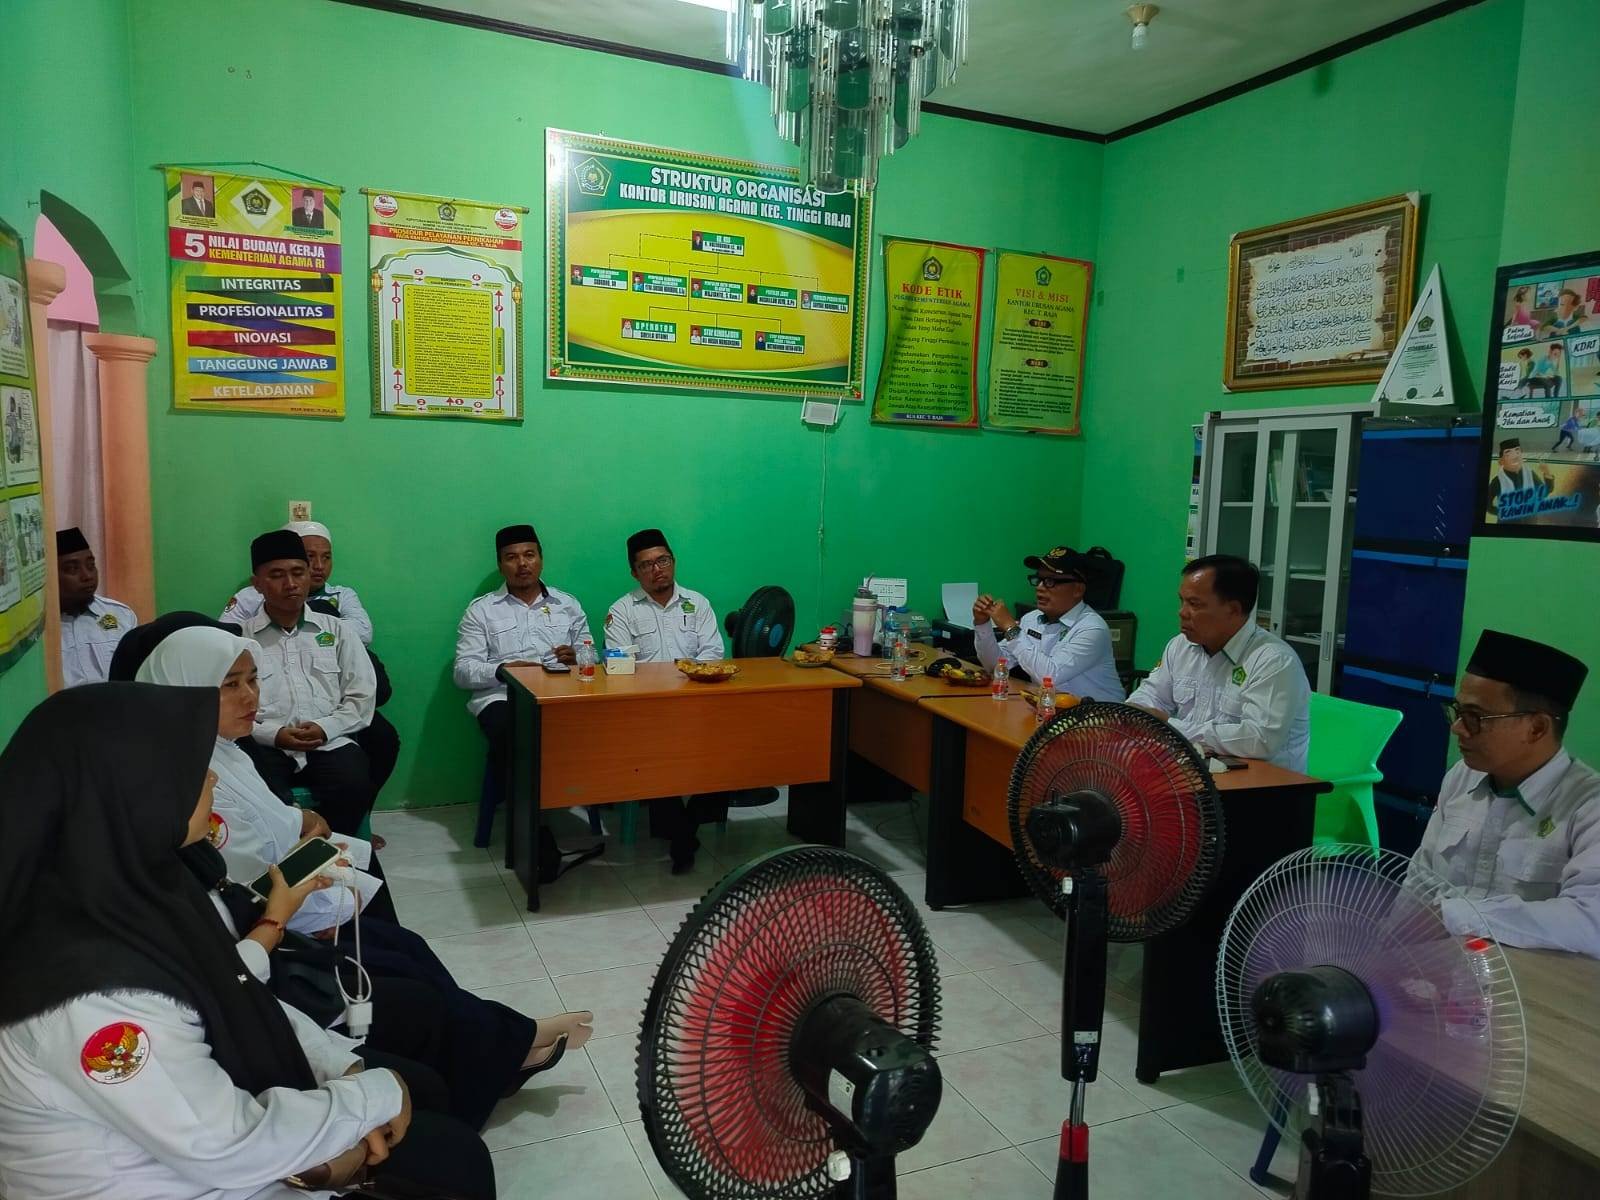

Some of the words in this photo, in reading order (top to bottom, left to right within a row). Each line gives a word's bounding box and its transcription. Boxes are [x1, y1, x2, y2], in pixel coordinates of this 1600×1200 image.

[651, 167, 732, 195] STRUKTUR
[735, 179, 826, 208] ORGANISASI
[619, 183, 666, 204] KANTOR
[669, 192, 715, 211] URUSAN
[718, 198, 757, 216] AGAMA
[760, 203, 784, 220] KEC.
[786, 206, 822, 225] TINGGI
[824, 212, 851, 229] RAJA
[423, 230, 461, 240] PELAYANAN
[184, 232, 206, 258] 5
[208, 235, 239, 250] NILAI
[242, 238, 287, 255] BUDAYA
[289, 243, 325, 258] KERJA
[208, 248, 277, 264] KEMENTERIAN
[279, 255, 312, 268] AGAMA
[315, 258, 325, 269] RI
[221, 278, 302, 291] INTEGRITAS
[902, 283, 932, 296] KODE
[937, 287, 962, 299] ETIK
[1015, 288, 1035, 299] VISI
[1038, 290, 1044, 299] &
[1048, 292, 1070, 303] MISI
[199, 305, 323, 318] PROFESIONALITAS
[1007, 298, 1031, 308] KANTOR
[1031, 301, 1054, 310] URUSAN
[1055, 304, 1075, 313] AGAMA
[234, 332, 291, 344] INOVASI
[1573, 340, 1597, 352] KDRT
[197, 358, 277, 371] TANGGUNG
[281, 358, 328, 370] JAWAB
[213, 384, 314, 397] KETELADANAN
[1502, 410, 1535, 418] Kematian
[1516, 417, 1530, 425] dan
[1499, 487, 1534, 507] STOP
[1500, 503, 1535, 519] KAWIN
